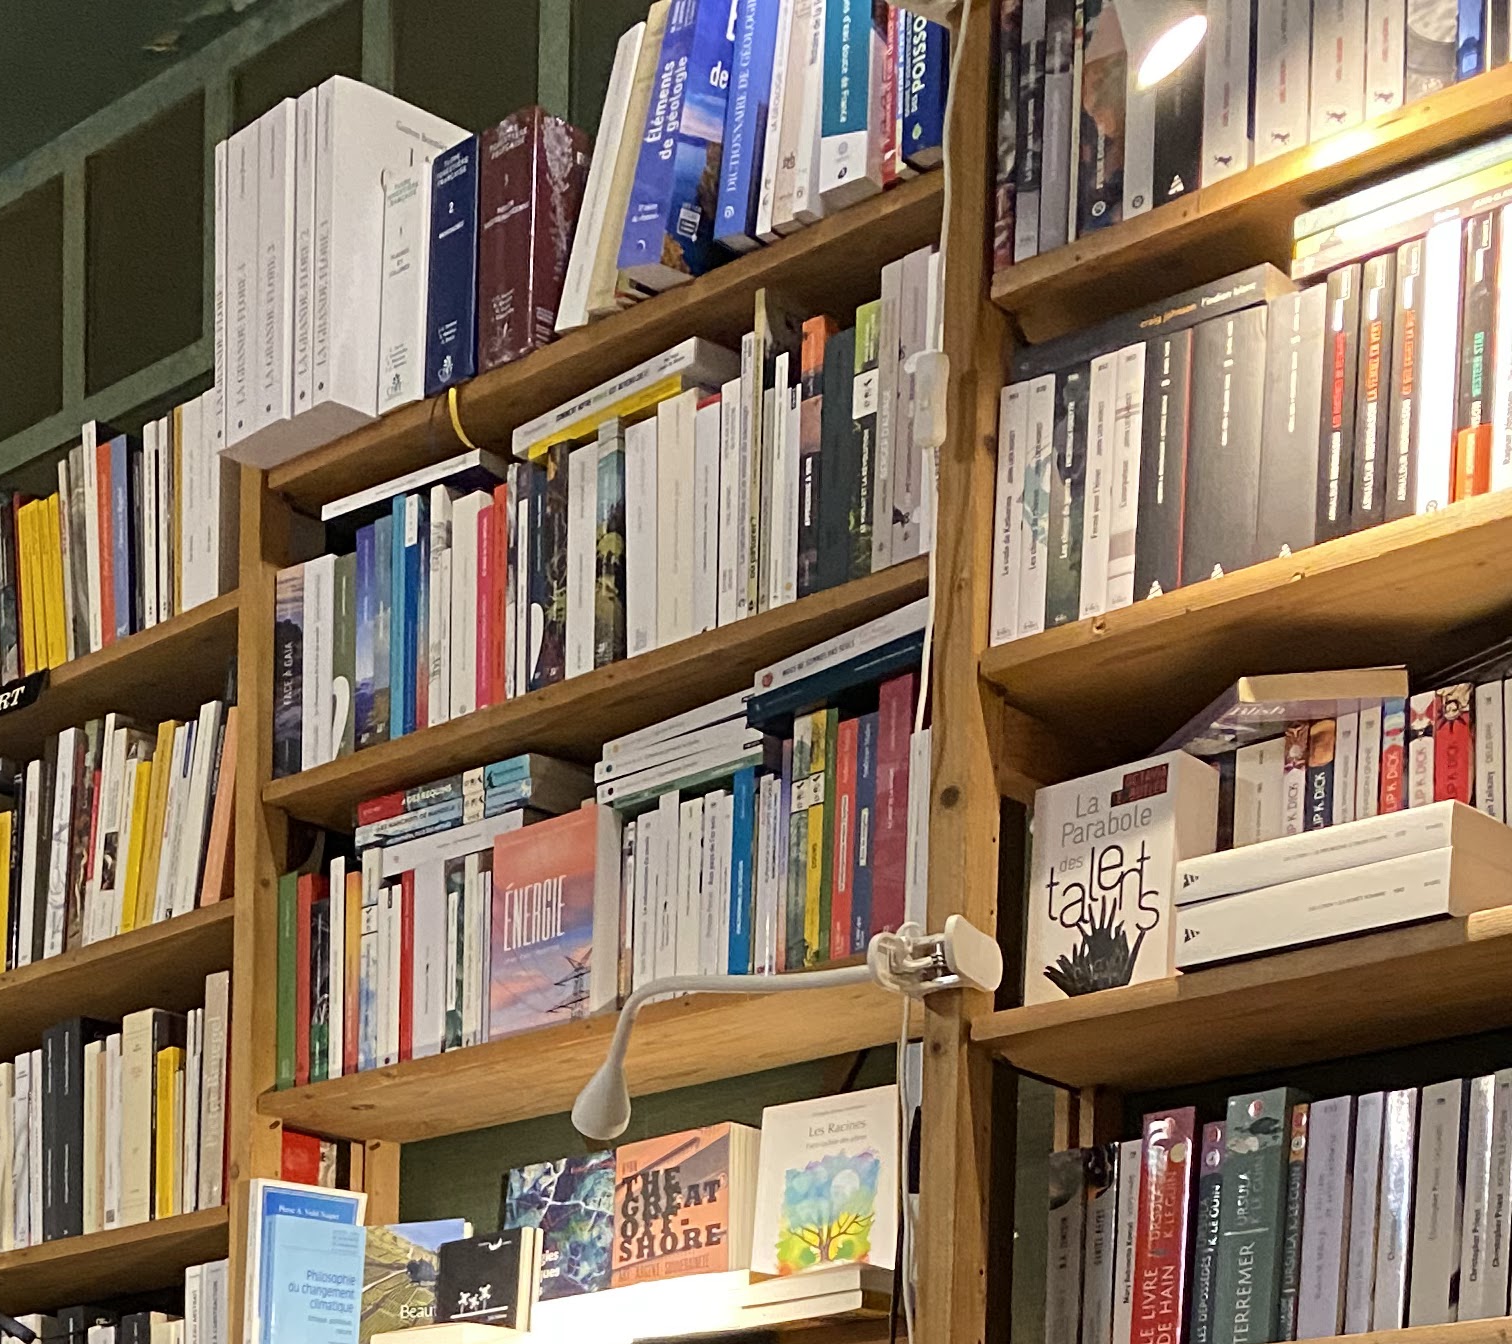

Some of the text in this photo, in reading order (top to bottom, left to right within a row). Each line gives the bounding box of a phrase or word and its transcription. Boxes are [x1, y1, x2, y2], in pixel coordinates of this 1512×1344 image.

[911, 16, 928, 90] POISSO
[735, 69, 750, 90] DE
[643, 60, 676, 142] Éléments
[658, 56, 689, 160] de géologie
[726, 91, 748, 192] DICTIONNAIRE
[448, 201, 454, 214] 2
[1362, 460, 1374, 510] ARNALDUR
[1397, 454, 1409, 501] ARNALDUR
[283, 679, 293, 706] FACE
[1387, 750, 1399, 779] DICK
[1415, 746, 1427, 774] DICK
[1448, 741, 1459, 769] DICK
[1287, 783, 1298, 809] DICK
[1313, 771, 1326, 799] DICK
[1076, 794, 1099, 818] La
[1061, 805, 1153, 848] Parabole
[1060, 856, 1084, 873] des
[1046, 840, 1159, 931] talents
[502, 874, 569, 952] ÉNERGIE
[808, 1119, 867, 1138] Les Racines
[621, 1166, 681, 1201] THE
[621, 1179, 721, 1222] GREAT
[1164, 1170, 1177, 1223] LE GUIN
[1235, 1170, 1251, 1227] URSULA
[1149, 1189, 1162, 1241] URSULA
[1494, 1193, 1504, 1217] Priest
[619, 1223, 722, 1263] SHORE
[620, 1214, 690, 1245] OFF-
[1209, 1220, 1220, 1234] LE
[1285, 1166, 1301, 1285] URSULA GUIN
[1469, 1209, 1481, 1282] Christopher Priest
[288, 1284, 356, 1302] du changement
[307, 1269, 356, 1287] Philosophie
[1141, 1267, 1159, 1320] LIVRE
[1159, 1265, 1176, 1315] HAIN
[309, 1298, 354, 1314] climatique
[1196, 1325, 1206, 1343] LES
